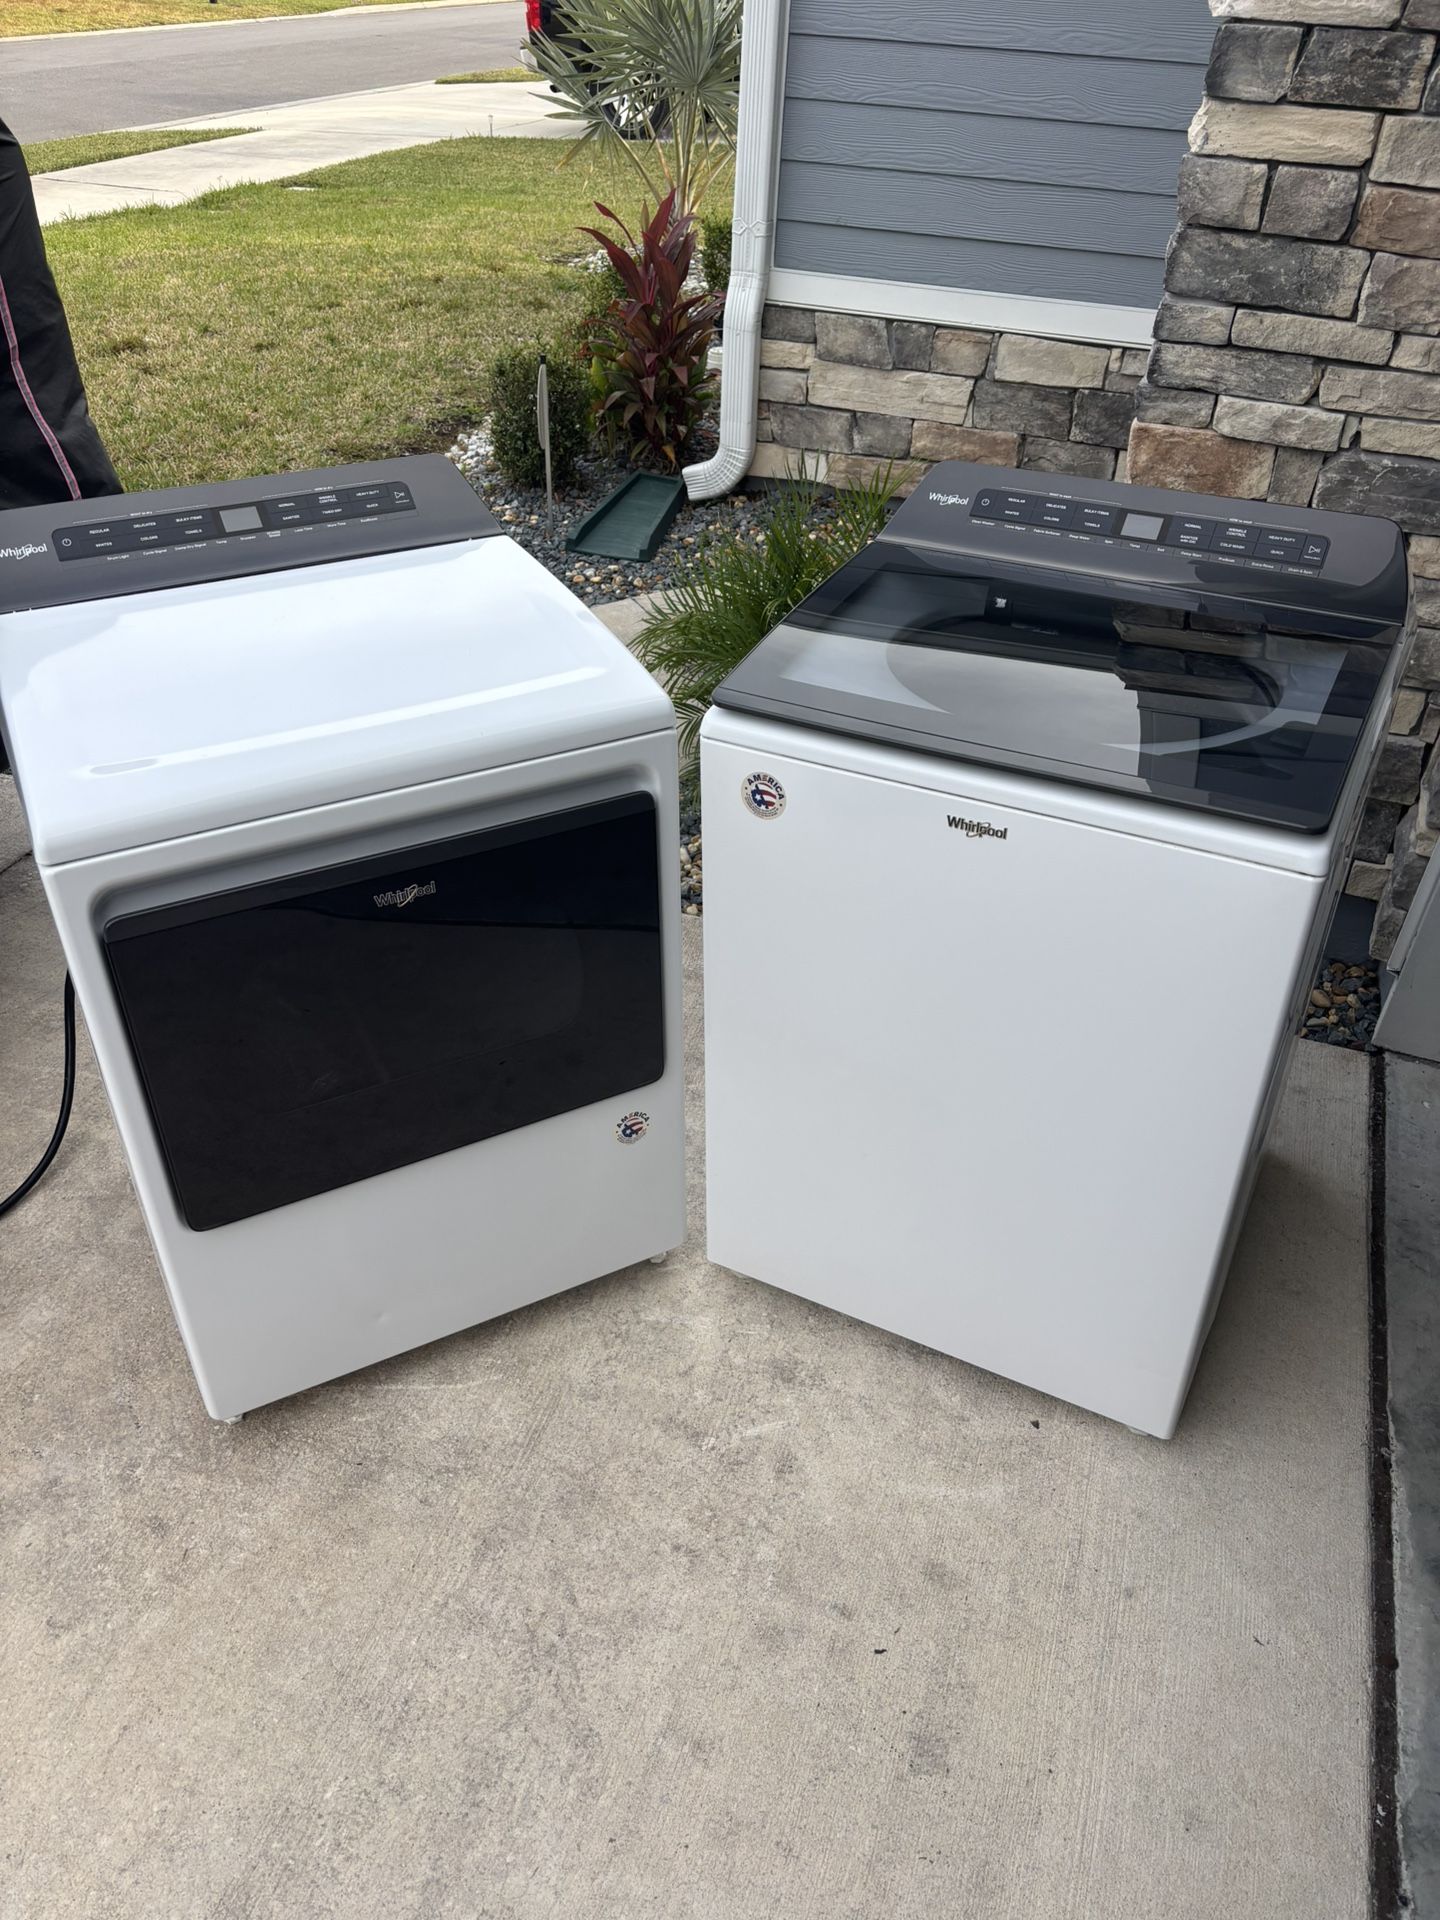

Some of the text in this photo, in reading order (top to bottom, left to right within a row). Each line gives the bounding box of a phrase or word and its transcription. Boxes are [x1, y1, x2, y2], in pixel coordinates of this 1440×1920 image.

[929, 492, 969, 505] Whirlpool
[0, 543, 48, 560] Whirlpool
[747, 774, 785, 800] AMERICA
[947, 815, 1008, 840] Whirlpool
[373, 881, 437, 907] Whirlpool
[617, 1111, 650, 1129] AMERICA
